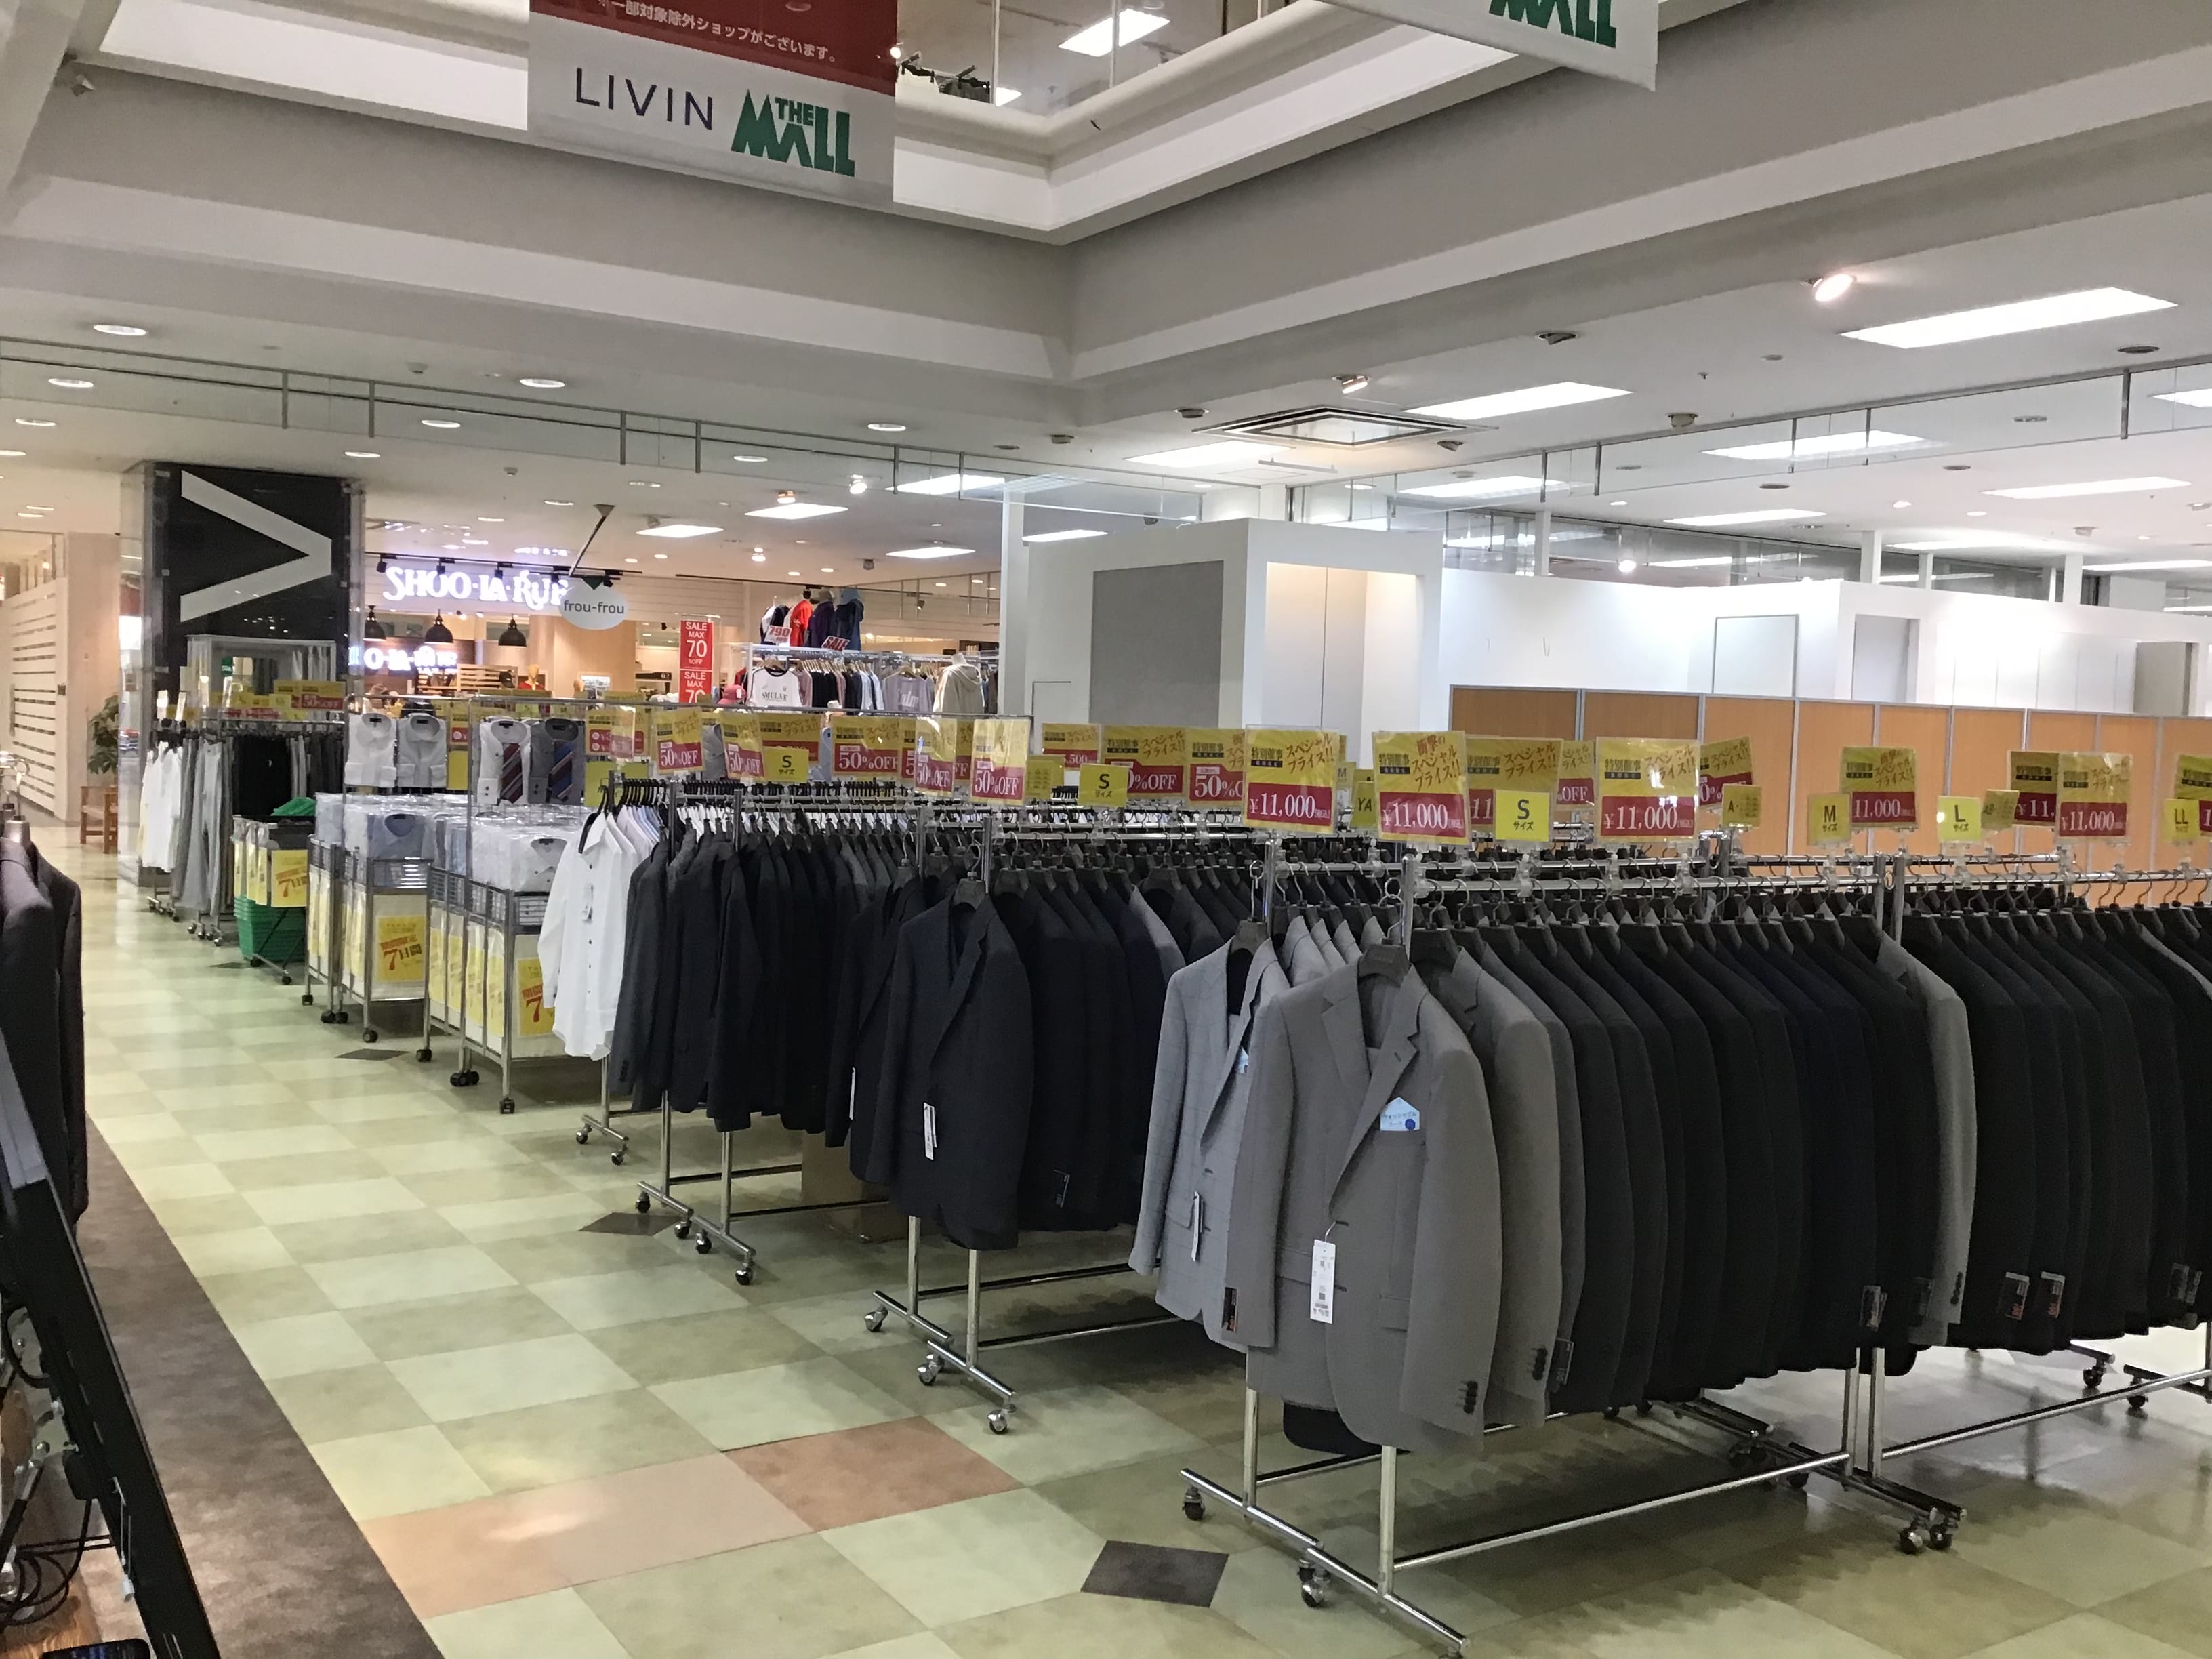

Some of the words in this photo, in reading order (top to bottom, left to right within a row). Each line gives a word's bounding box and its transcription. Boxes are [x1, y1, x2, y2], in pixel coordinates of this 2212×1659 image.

[1489, 0, 1616, 48] ALL
[576, 68, 712, 130] LIVIN
[775, 97, 814, 126] THE
[731, 89, 855, 177] MALL
[564, 600, 625, 615] frou-frou
[686, 621, 708, 631] SALE
[769, 626, 790, 638] 790
[687, 639, 708, 658] 70
[823, 636, 848, 651] SALE
[684, 671, 706, 680] SALE
[781, 755, 792, 768] S
[975, 770, 1019, 796] 50%OFF
[1098, 773, 1111, 790] S
[1194, 775, 1243, 798] 50%O
[1561, 785, 1589, 801] OFF
[1249, 792, 1315, 819] ¥11,000
[1517, 799, 1530, 820] S
[1824, 805, 1836, 823] M
[1853, 799, 1901, 819] 11,000
[1954, 804, 1966, 822] L
[1382, 802, 1448, 830] ¥11,000
[1603, 806, 1678, 830] ¥11,000
[2175, 808, 2189, 825] LL
[1513, 821, 1534, 832] サイズ
